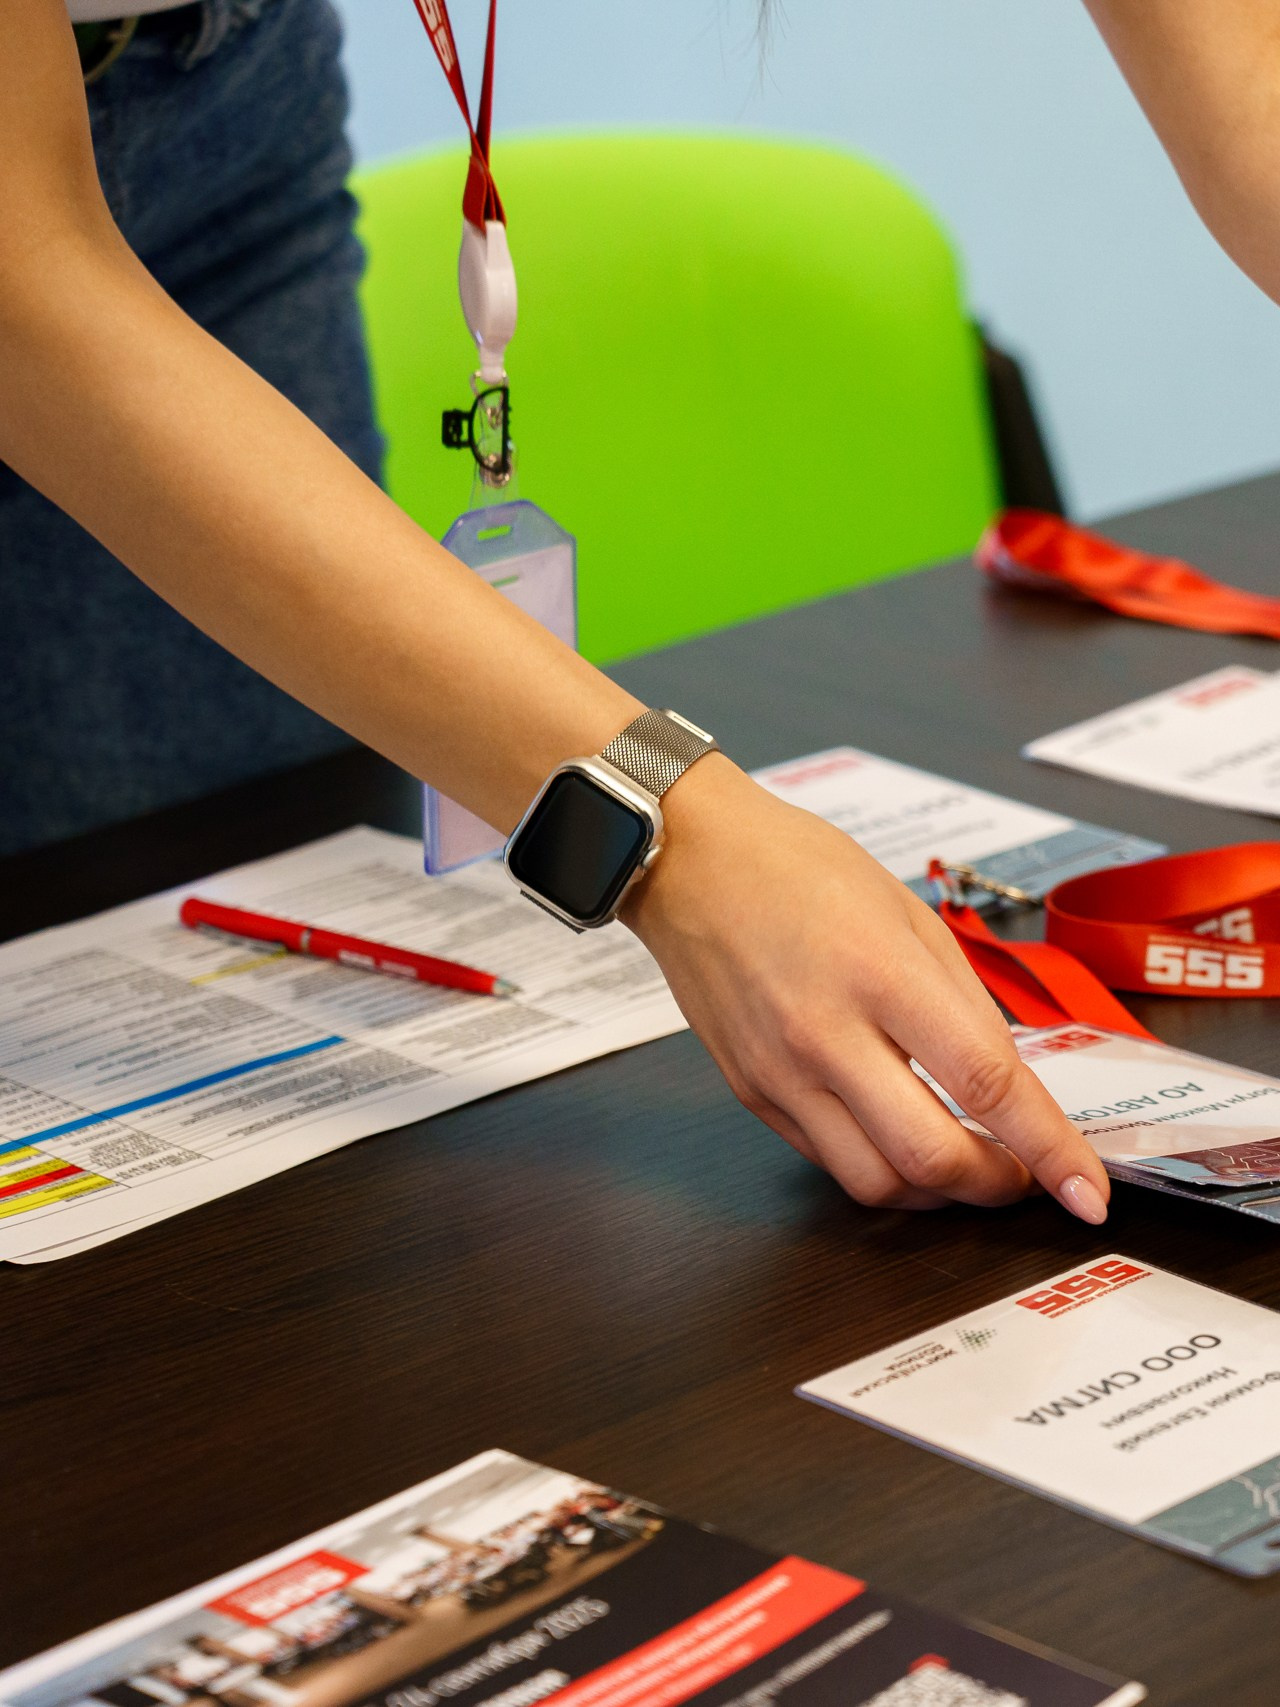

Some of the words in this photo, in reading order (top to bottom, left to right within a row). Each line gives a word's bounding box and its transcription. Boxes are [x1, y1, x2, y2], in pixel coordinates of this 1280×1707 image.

[1144, 943, 1264, 990] 555
[1067, 1094, 1160, 1122] АВТОВ
[1157, 1081, 1205, 1099] АО
[1015, 1260, 1146, 1315] 555
[1141, 1334, 1221, 1371] ООО
[1014, 1371, 1141, 1427] СИГМА
[1100, 1366, 1237, 1430] Николаевич
[1114, 1405, 1208, 1452] Евгений
